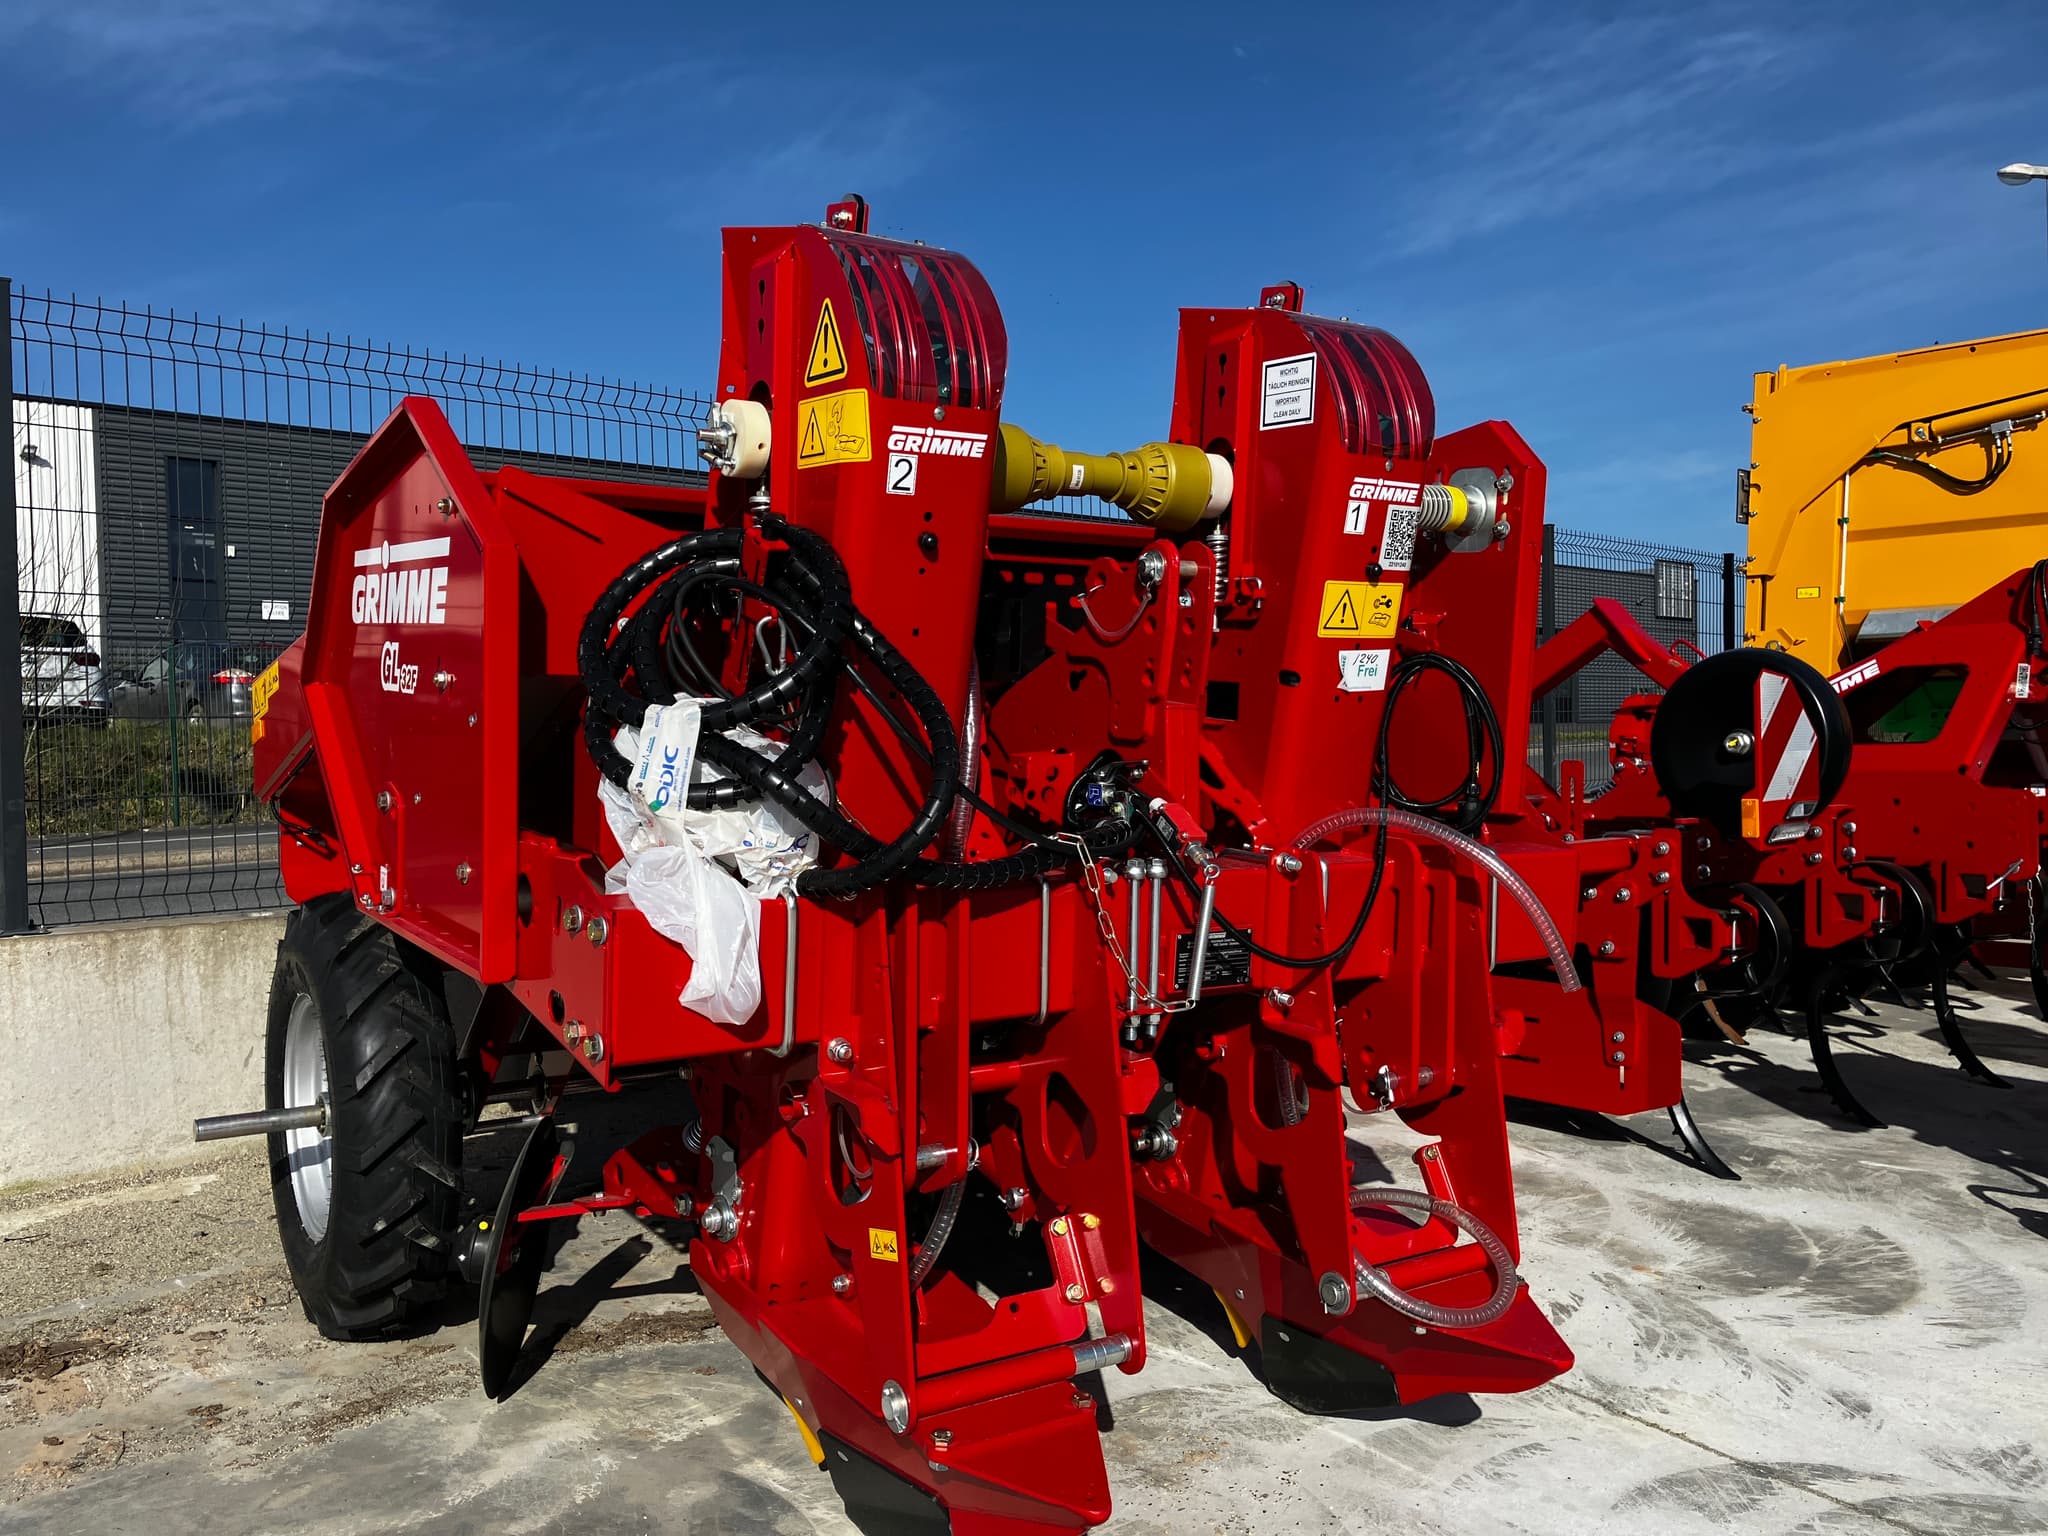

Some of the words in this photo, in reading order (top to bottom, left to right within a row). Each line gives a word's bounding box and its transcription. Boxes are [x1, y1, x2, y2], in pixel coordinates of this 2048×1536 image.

[1280, 367, 1299, 376] WICHTIG
[1288, 377, 1310, 387] REINIGEN
[1273, 410, 1288, 418] CLEAN
[1289, 408, 1302, 416] DAILY
[1275, 396, 1301, 406] IMPORTANT
[887, 427, 987, 458] GRIMME
[891, 458, 913, 491] 2
[1349, 479, 1420, 503] GRIMME
[1351, 503, 1361, 531] 1
[352, 540, 449, 624] GRIMME
[381, 641, 400, 692] GL
[1357, 664, 1379, 677] Frei
